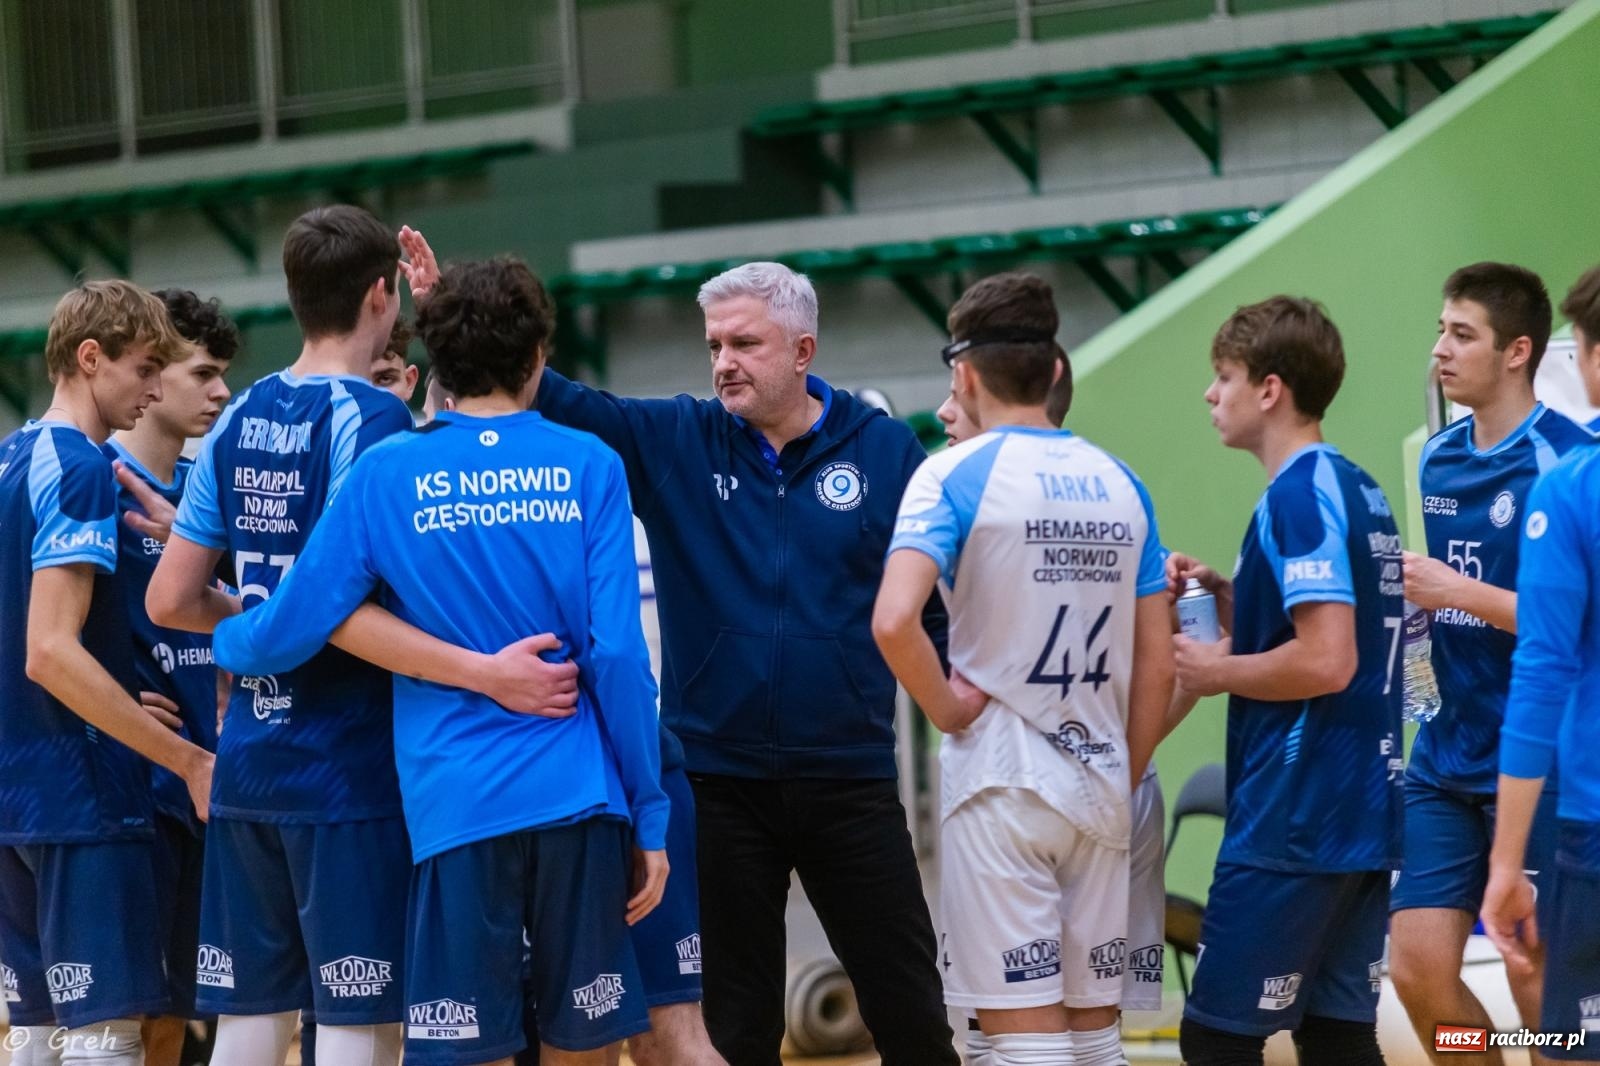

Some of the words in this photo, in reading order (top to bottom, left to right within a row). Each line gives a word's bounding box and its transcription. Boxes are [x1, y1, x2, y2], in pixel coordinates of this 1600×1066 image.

[415, 470, 452, 501] KS
[459, 466, 572, 496] NORWID
[1035, 472, 1110, 502] TARKA
[413, 499, 583, 534] CZĘSTOCHOWA
[1025, 519, 1134, 542] HEMARPOL
[1043, 547, 1119, 568] NORWID
[1447, 539, 1483, 581] 55
[177, 647, 216, 666] HEMA
[1024, 604, 1114, 702] 44
[1383, 617, 1402, 695] 7
[676, 935, 702, 960] WŁO
[197, 946, 234, 974] ODAR
[320, 959, 392, 982] WŁODAR
[1134, 971, 1163, 983] TRA
[329, 984, 383, 998] TRADE
[573, 977, 625, 1006] WŁODAR
[409, 1001, 478, 1024] WŁODAR
[584, 997, 620, 1020] TRADE
[427, 1028, 460, 1037] BETON
